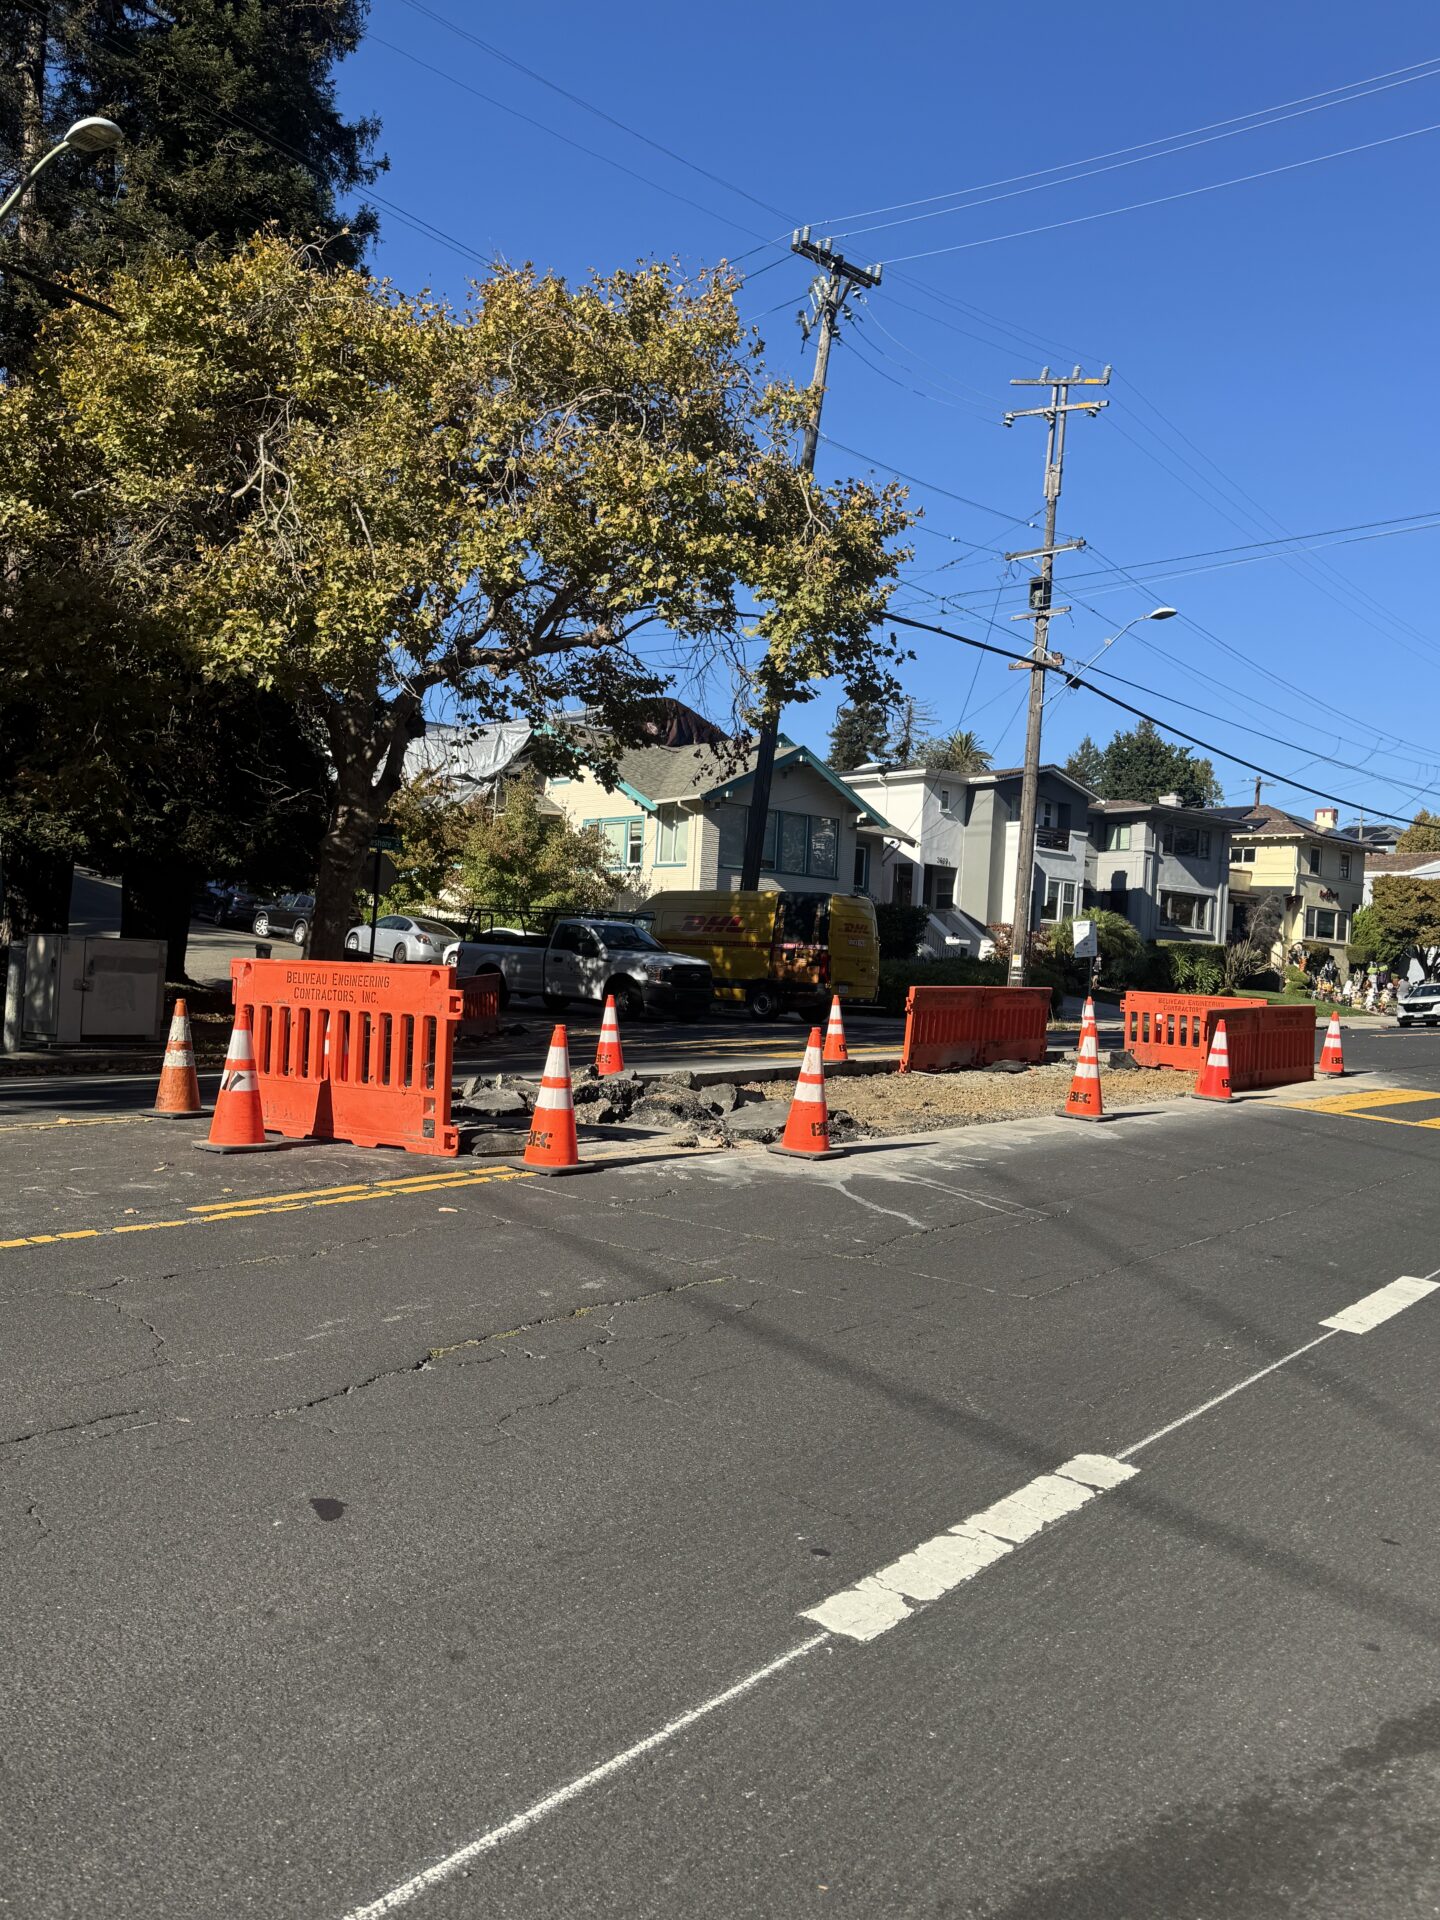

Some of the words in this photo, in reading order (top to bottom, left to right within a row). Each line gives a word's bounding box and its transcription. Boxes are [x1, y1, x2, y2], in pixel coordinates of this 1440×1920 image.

[680, 915, 745, 932] DHL
[842, 922, 870, 934] DHL
[286, 970, 328, 985] BELIVEAU
[332, 972, 390, 988] ENGINEERING
[293, 986, 357, 1004] CONTRACTORS,
[361, 990, 379, 1004] INC.
[1069, 1091, 1092, 1105] BEC
